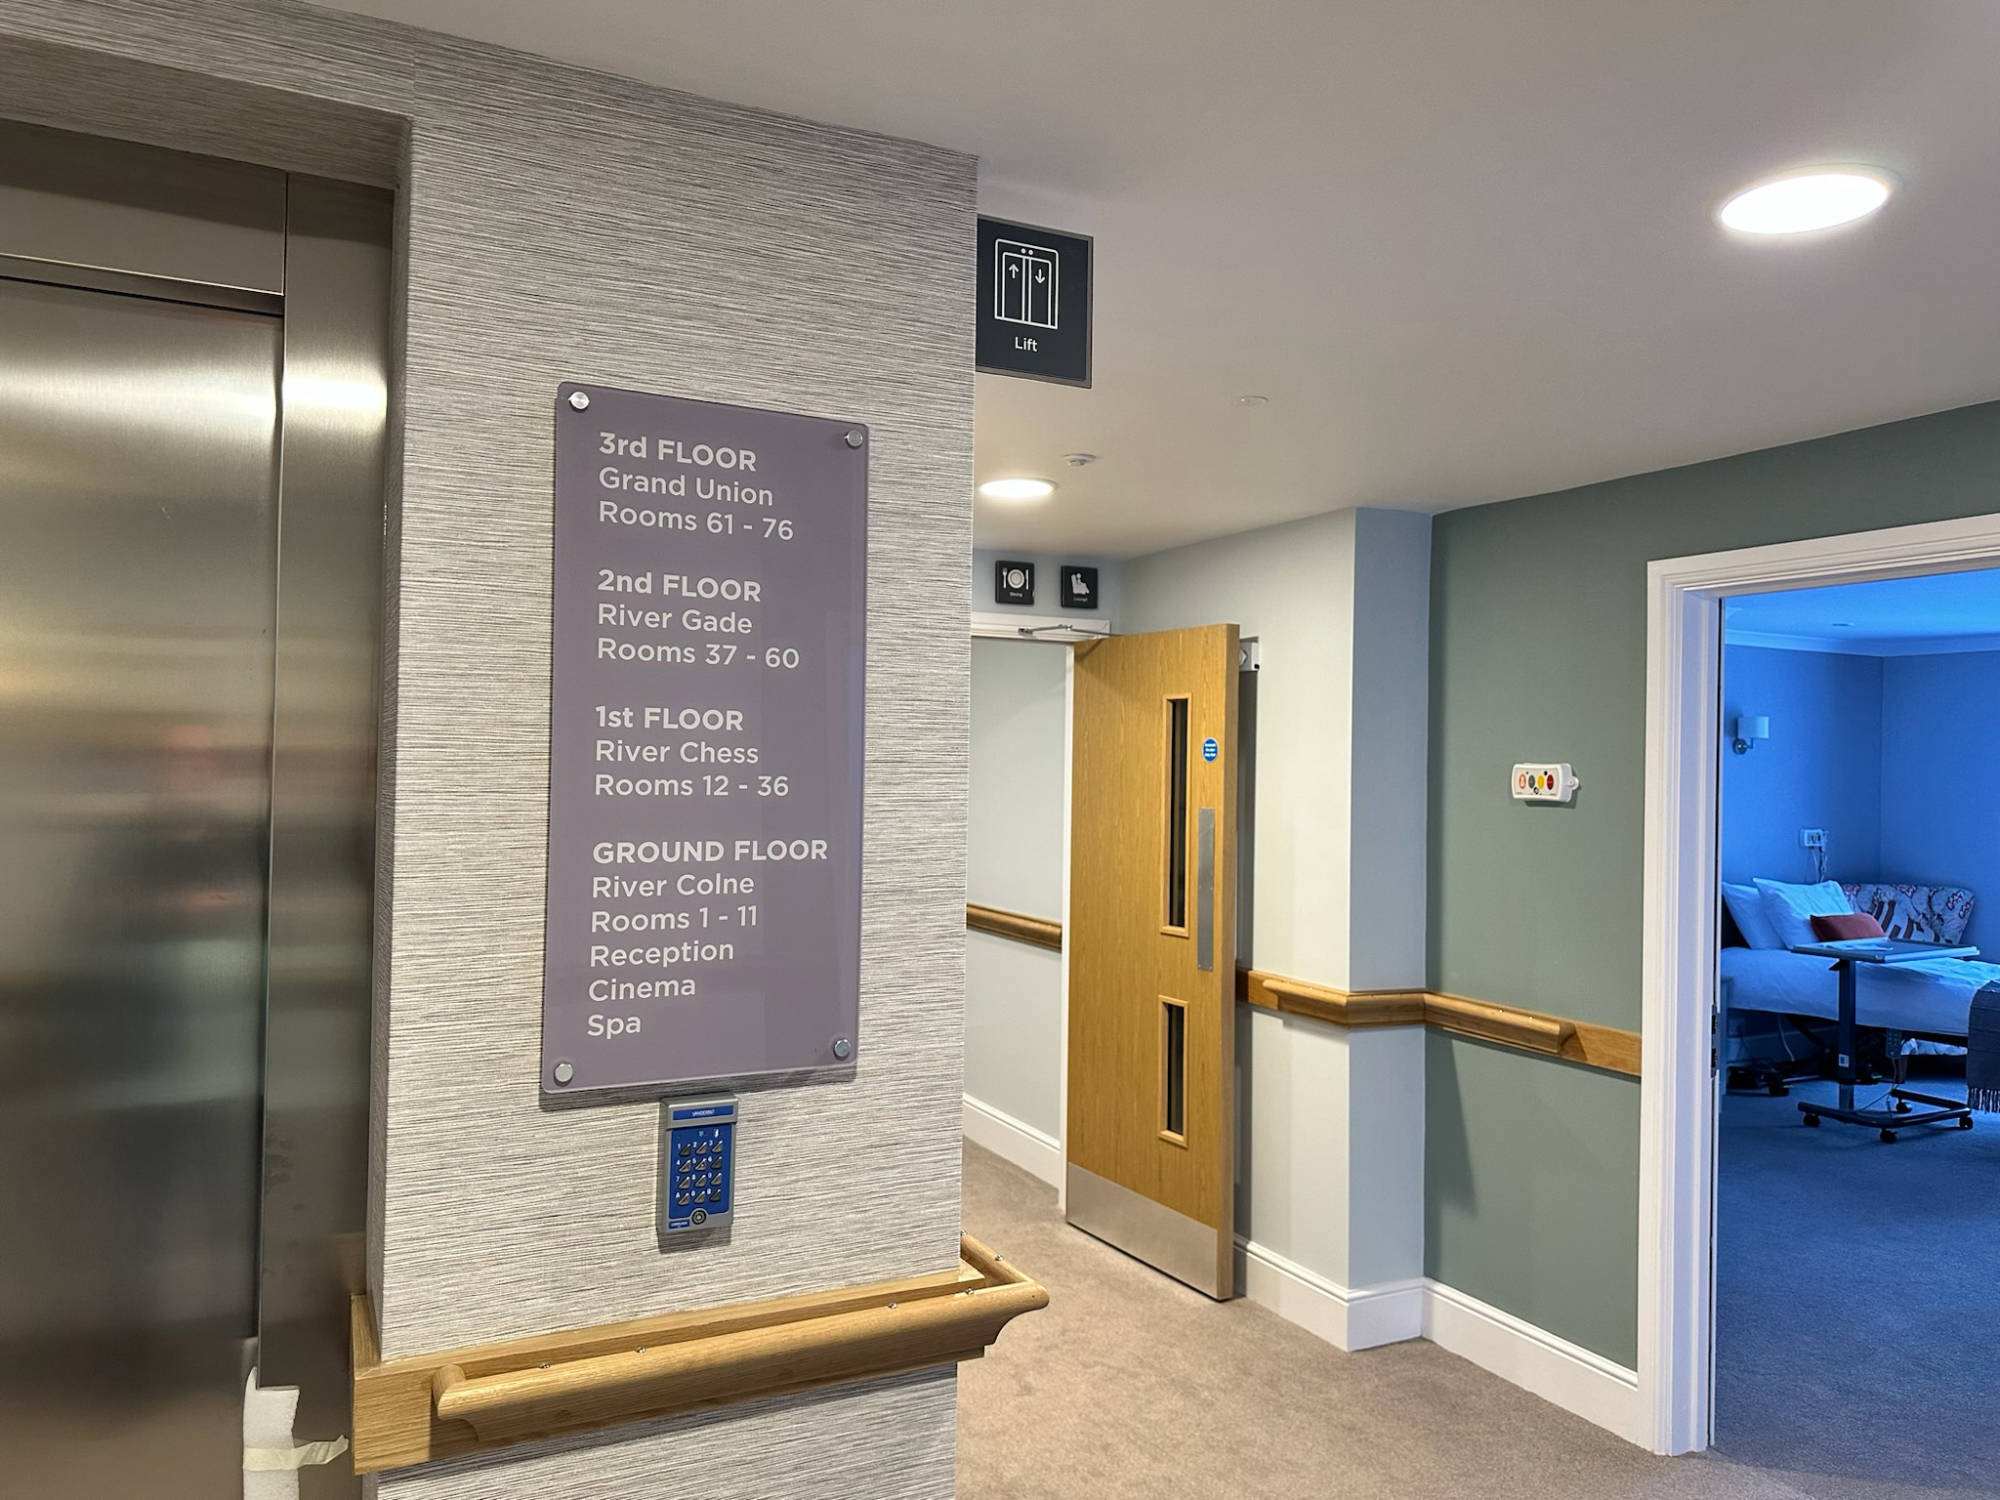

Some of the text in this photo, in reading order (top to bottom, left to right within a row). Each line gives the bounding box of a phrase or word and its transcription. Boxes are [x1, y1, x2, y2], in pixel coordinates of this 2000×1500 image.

[1015, 337, 1037, 351] Lift
[600, 432, 756, 471] 3rd FLOOR
[600, 467, 772, 506] Grand Union
[600, 501, 697, 530] Rooms
[707, 513, 732, 534] 61
[763, 518, 793, 540] 76
[598, 569, 760, 602] 2nd FLOOR
[599, 603, 752, 633] River Gade
[598, 638, 695, 663] Rooms
[705, 644, 737, 665] 37
[766, 648, 799, 668] 60
[596, 706, 743, 731] 1st FLOOR
[596, 740, 758, 763] River Chess
[595, 774, 693, 795] Rooms
[703, 775, 728, 795] 12
[757, 776, 788, 796] 36
[593, 840, 827, 864] GROUND FLOOR
[593, 873, 754, 898] River Colne
[592, 911, 690, 933] Rooms
[699, 907, 708, 928] 1
[738, 905, 756, 926] 11
[591, 940, 733, 967] Reception
[589, 978, 695, 1001] Cinema
[587, 1014, 640, 1039] Spa
